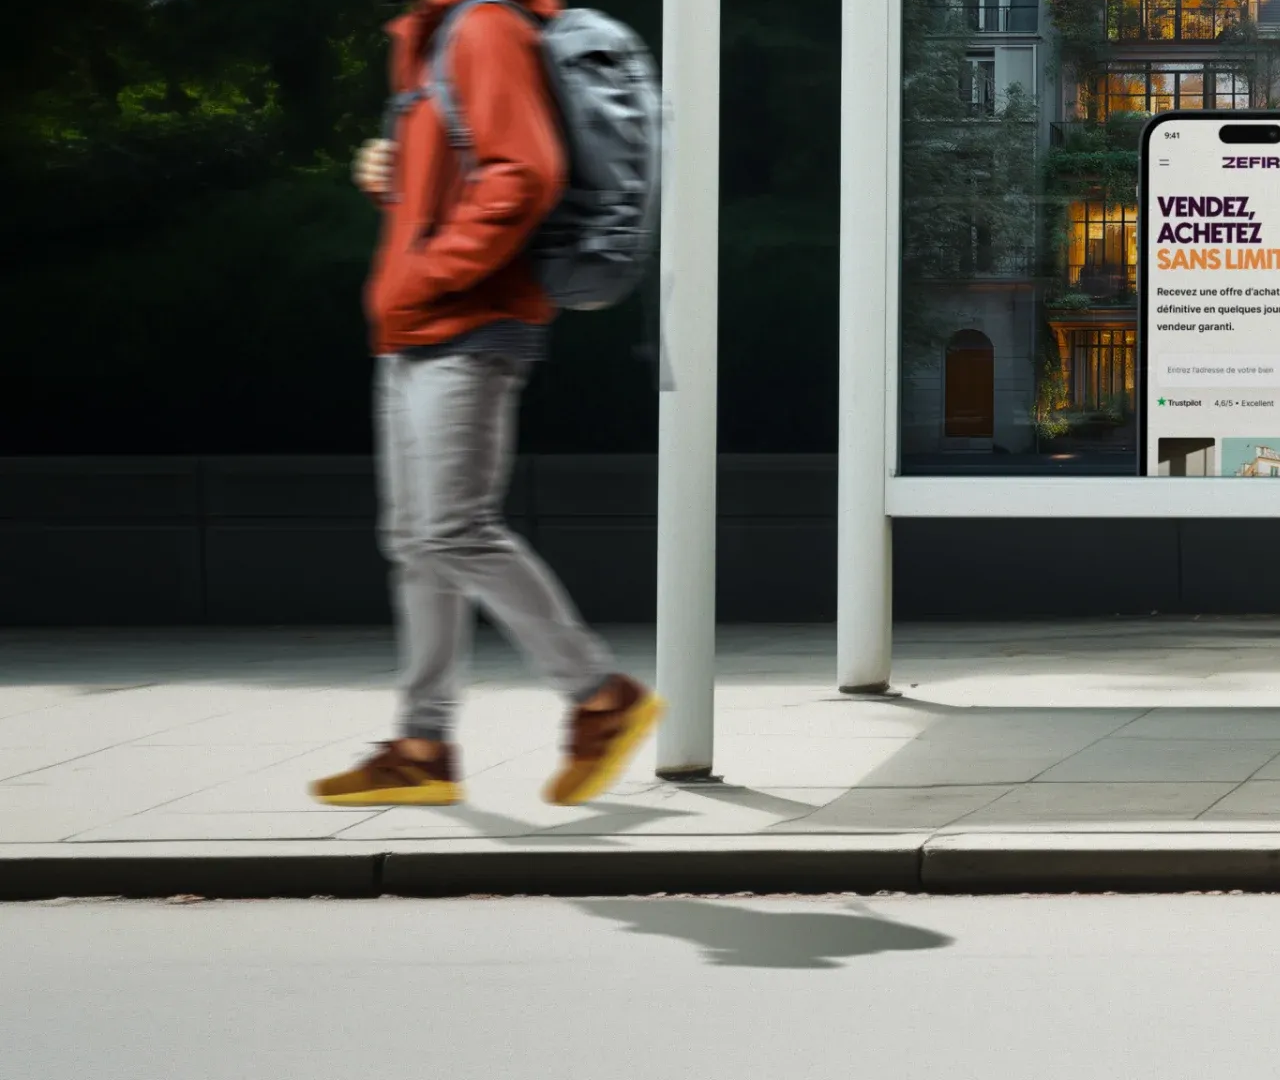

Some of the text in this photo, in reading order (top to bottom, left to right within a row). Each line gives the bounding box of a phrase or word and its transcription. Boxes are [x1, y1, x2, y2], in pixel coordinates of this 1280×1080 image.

[1164, 132, 1180, 140] 9:41
[1222, 156, 1280, 169] ZEFIR
[1157, 196, 1255, 220] VENDEZ,
[1157, 222, 1262, 244] ACHETEZ
[1157, 248, 1222, 270] SANS
[1157, 288, 1197, 297] Recevez
[1200, 289, 1217, 297] une
[1220, 287, 1243, 297] offre
[1245, 288, 1280, 297] d'achat
[1157, 305, 1201, 314] définitive
[1204, 306, 1215, 314] en
[1218, 305, 1261, 316] quelques
[1157, 322, 1234, 334] vendeur garanti.
[1168, 366, 1190, 374] Entrez
[1226, 366, 1235, 374] de
[1237, 366, 1256, 374] votre
[1168, 399, 1202, 408] Trustpilot
[1214, 399, 1274, 408] 4,6/5 Excellent
